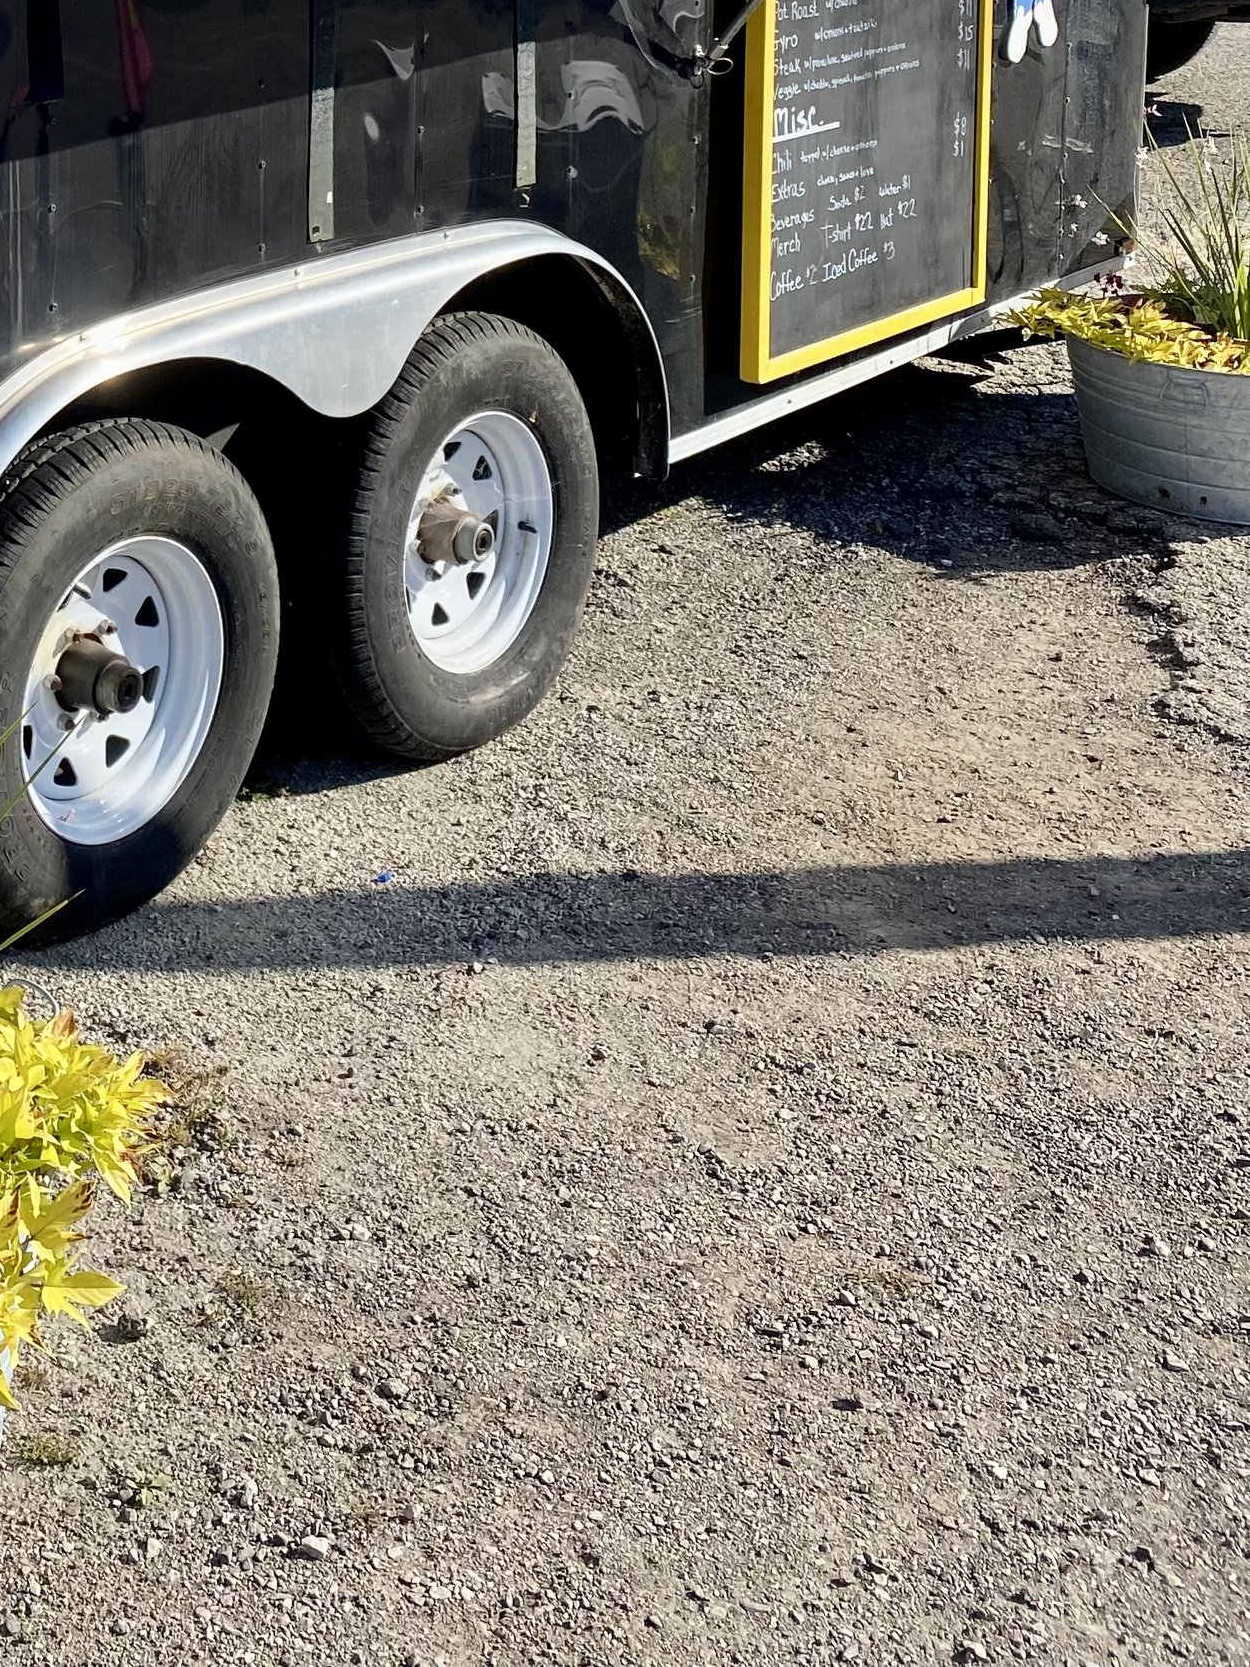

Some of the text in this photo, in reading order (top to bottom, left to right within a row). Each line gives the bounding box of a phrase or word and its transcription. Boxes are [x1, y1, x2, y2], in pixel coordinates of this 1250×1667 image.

[791, 0, 820, 21] Roast
[773, 20, 974, 76] Steak $15
[773, 82, 802, 101] Veggie
[956, 47, 970, 70] $11
[773, 105, 824, 137] Misc.
[953, 111, 967, 139] $8
[771, 178, 806, 203] Extras
[953, 139, 964, 158] $1
[771, 208, 815, 233] Beverages
[827, 194, 852, 211] Soda
[854, 184, 866, 203] $2
[902, 174, 911, 190] $1
[771, 198, 918, 258] Merch T-shirt $22 Hat $22
[770, 240, 896, 301] Coffee $2 Iced Coffee $3
